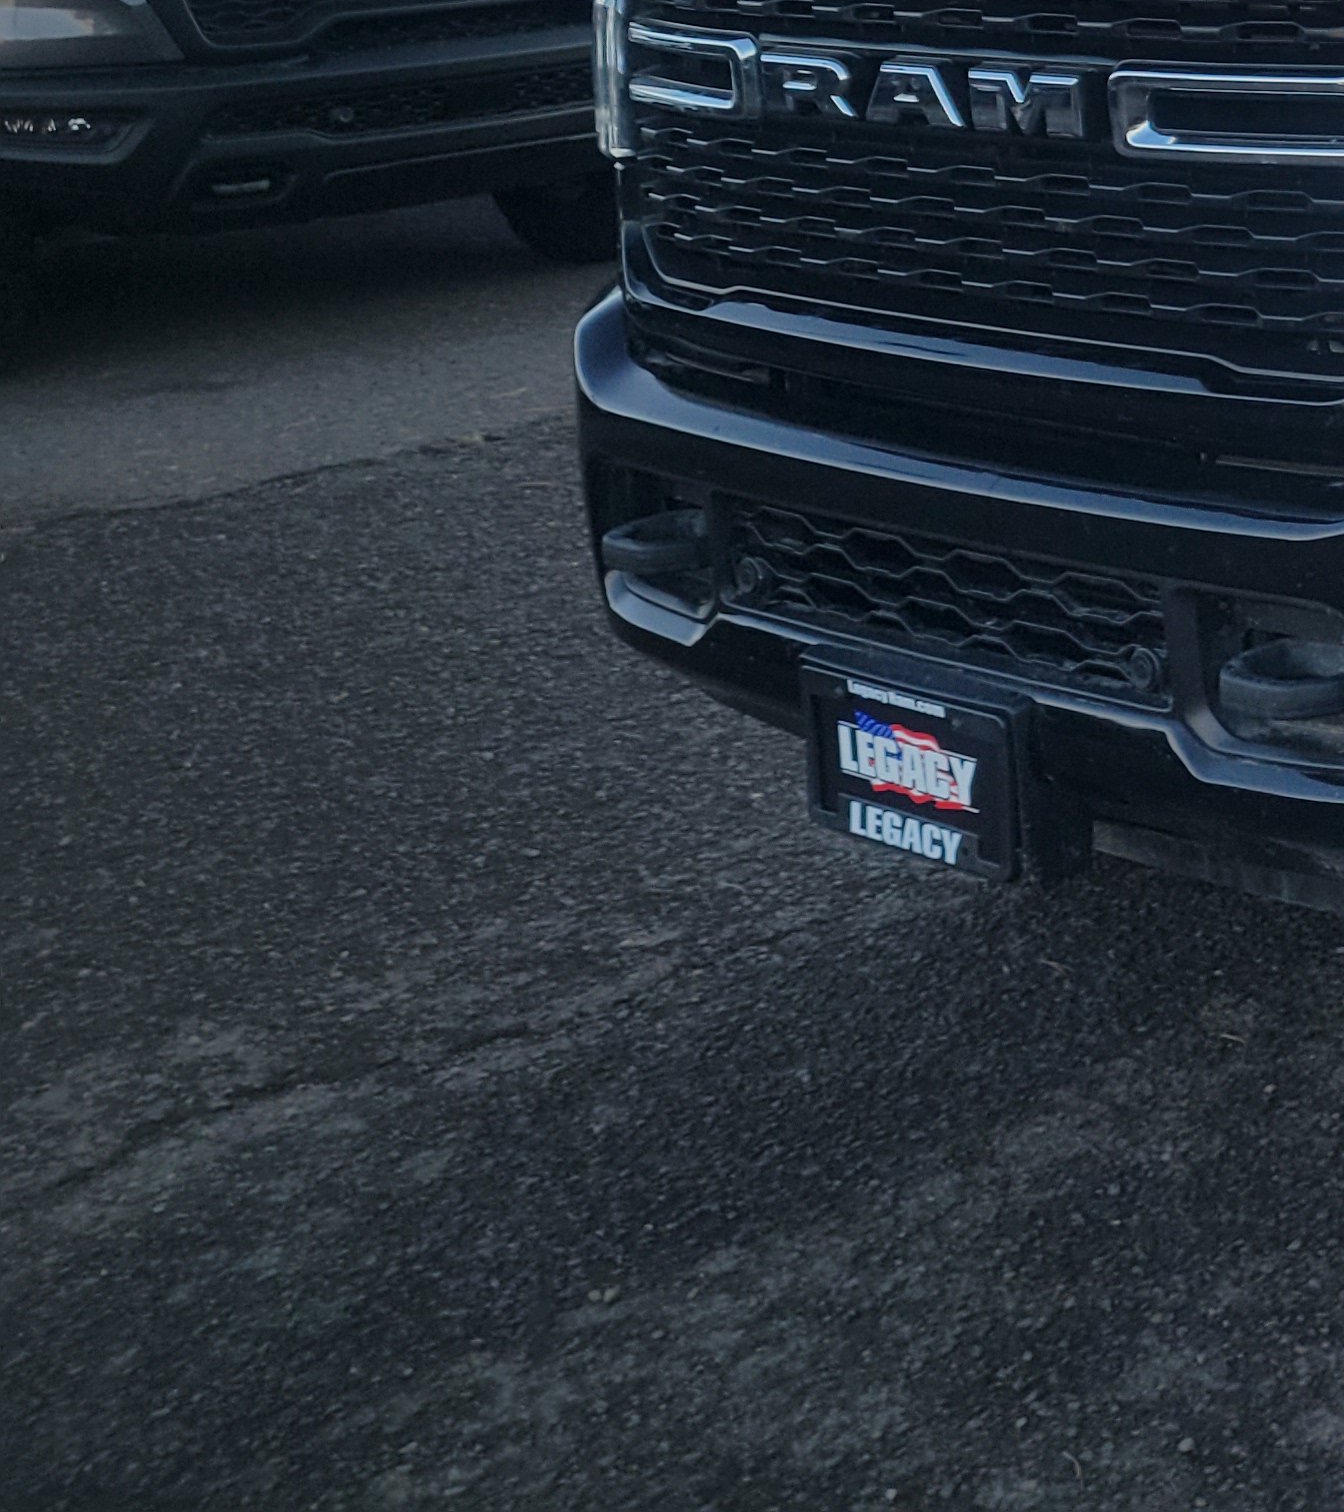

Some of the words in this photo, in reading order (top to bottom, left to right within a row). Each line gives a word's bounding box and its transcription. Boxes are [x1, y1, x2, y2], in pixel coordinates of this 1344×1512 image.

[756, 51, 1085, 138] RAM
[838, 723, 978, 807] LEGACY
[849, 800, 963, 866] LEGACY
